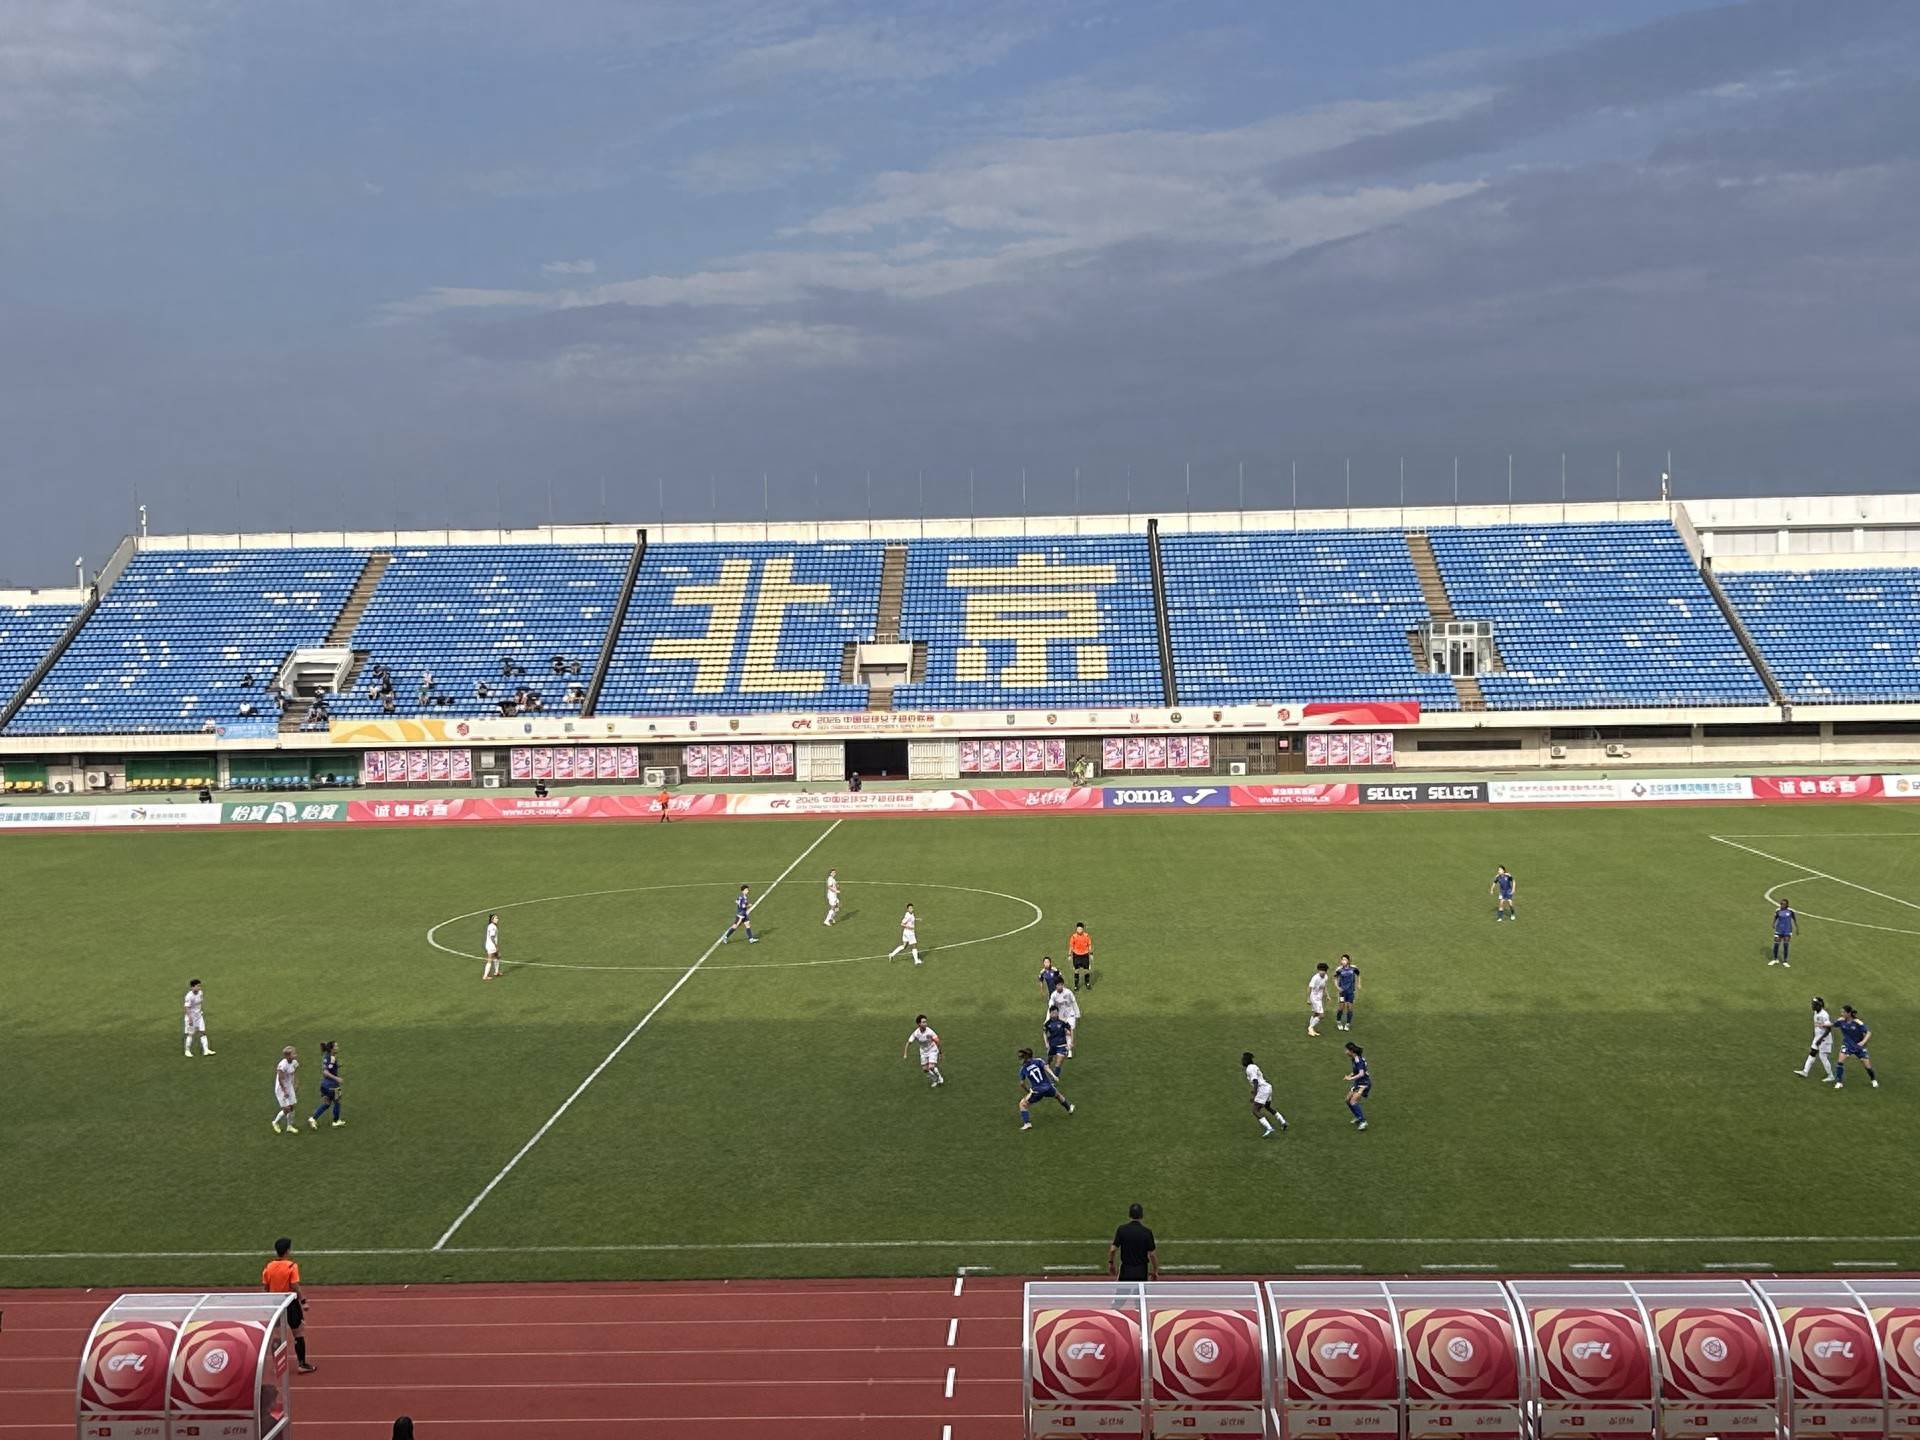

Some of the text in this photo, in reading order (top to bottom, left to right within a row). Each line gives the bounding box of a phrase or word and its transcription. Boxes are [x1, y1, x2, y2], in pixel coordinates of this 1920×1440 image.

[649, 553, 1117, 695] 北京
[1367, 785, 1479, 801] SELECT SELECT
[1029, 1067, 1044, 1083] 17
[1066, 1341, 1106, 1360] CFL
[1320, 1341, 1360, 1360] CFL
[1571, 1340, 1612, 1360] CFL
[1813, 1339, 1854, 1359] CFL
[108, 1352, 147, 1372] CFL
